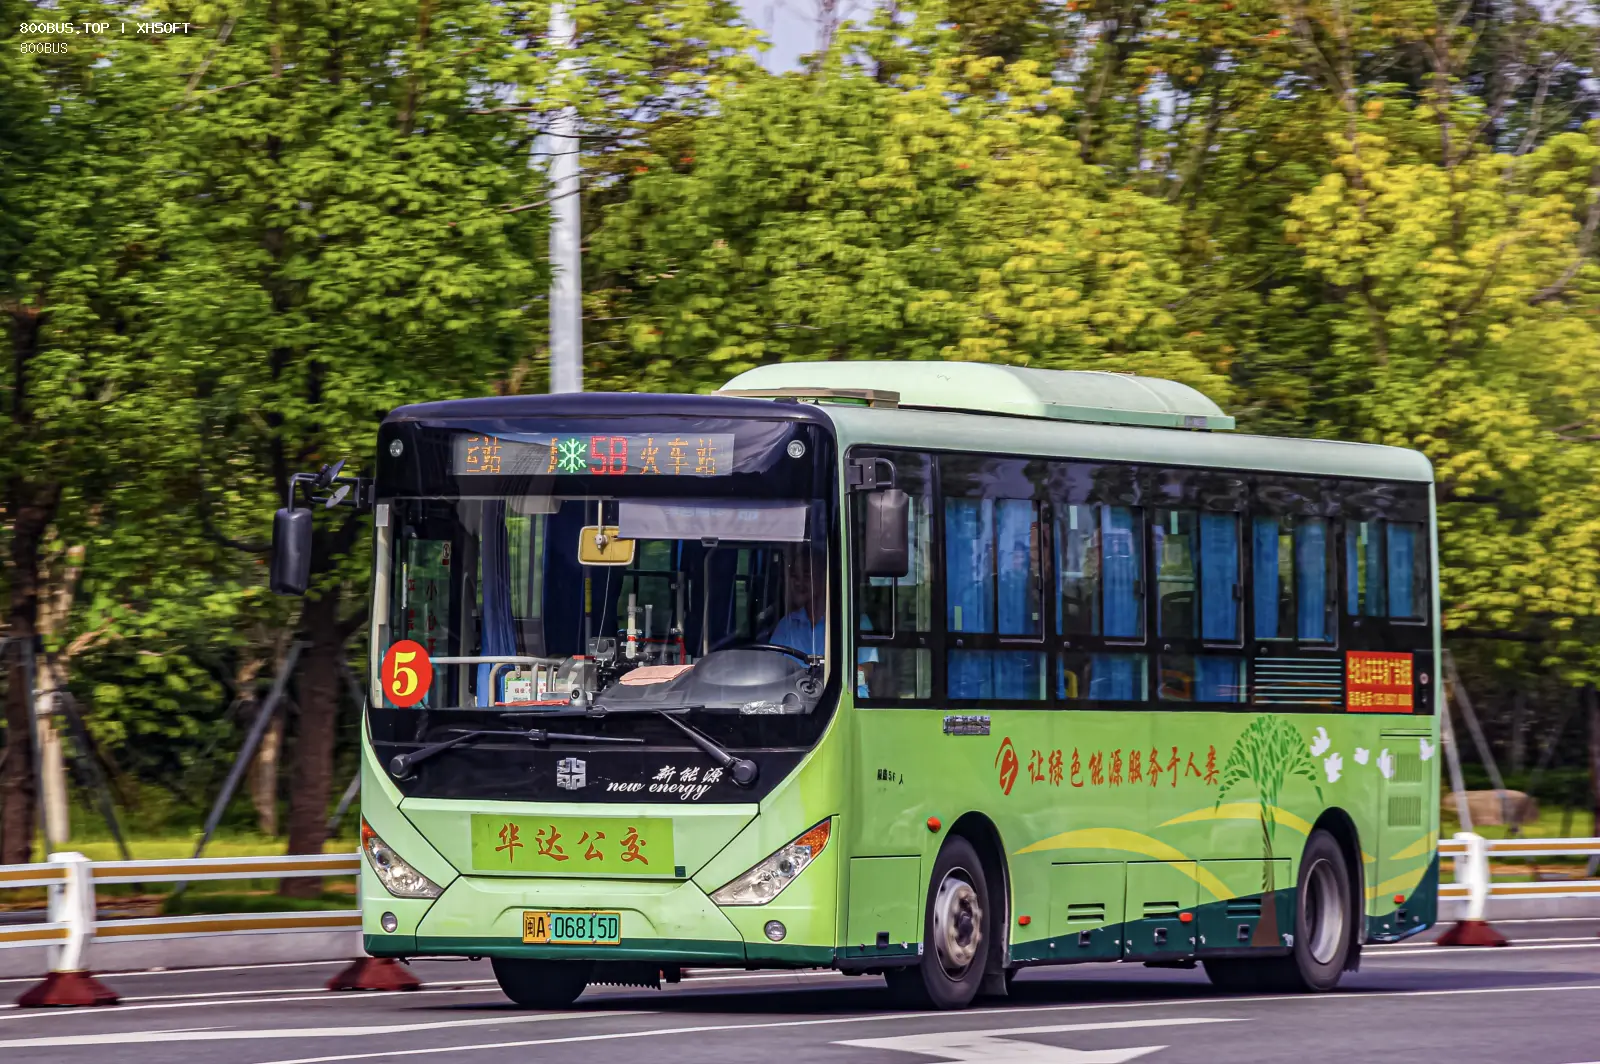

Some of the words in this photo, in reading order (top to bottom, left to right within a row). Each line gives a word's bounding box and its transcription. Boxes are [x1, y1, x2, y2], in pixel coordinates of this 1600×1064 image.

[640, 437, 717, 475] 火车站
[392, 651, 419, 697] 5
[652, 765, 724, 784] 新能源
[1027, 744, 1220, 788] 让绿色能源服务于人类
[606, 782, 646, 792] new
[648, 782, 712, 801] energy
[495, 822, 649, 865] 华达公交
